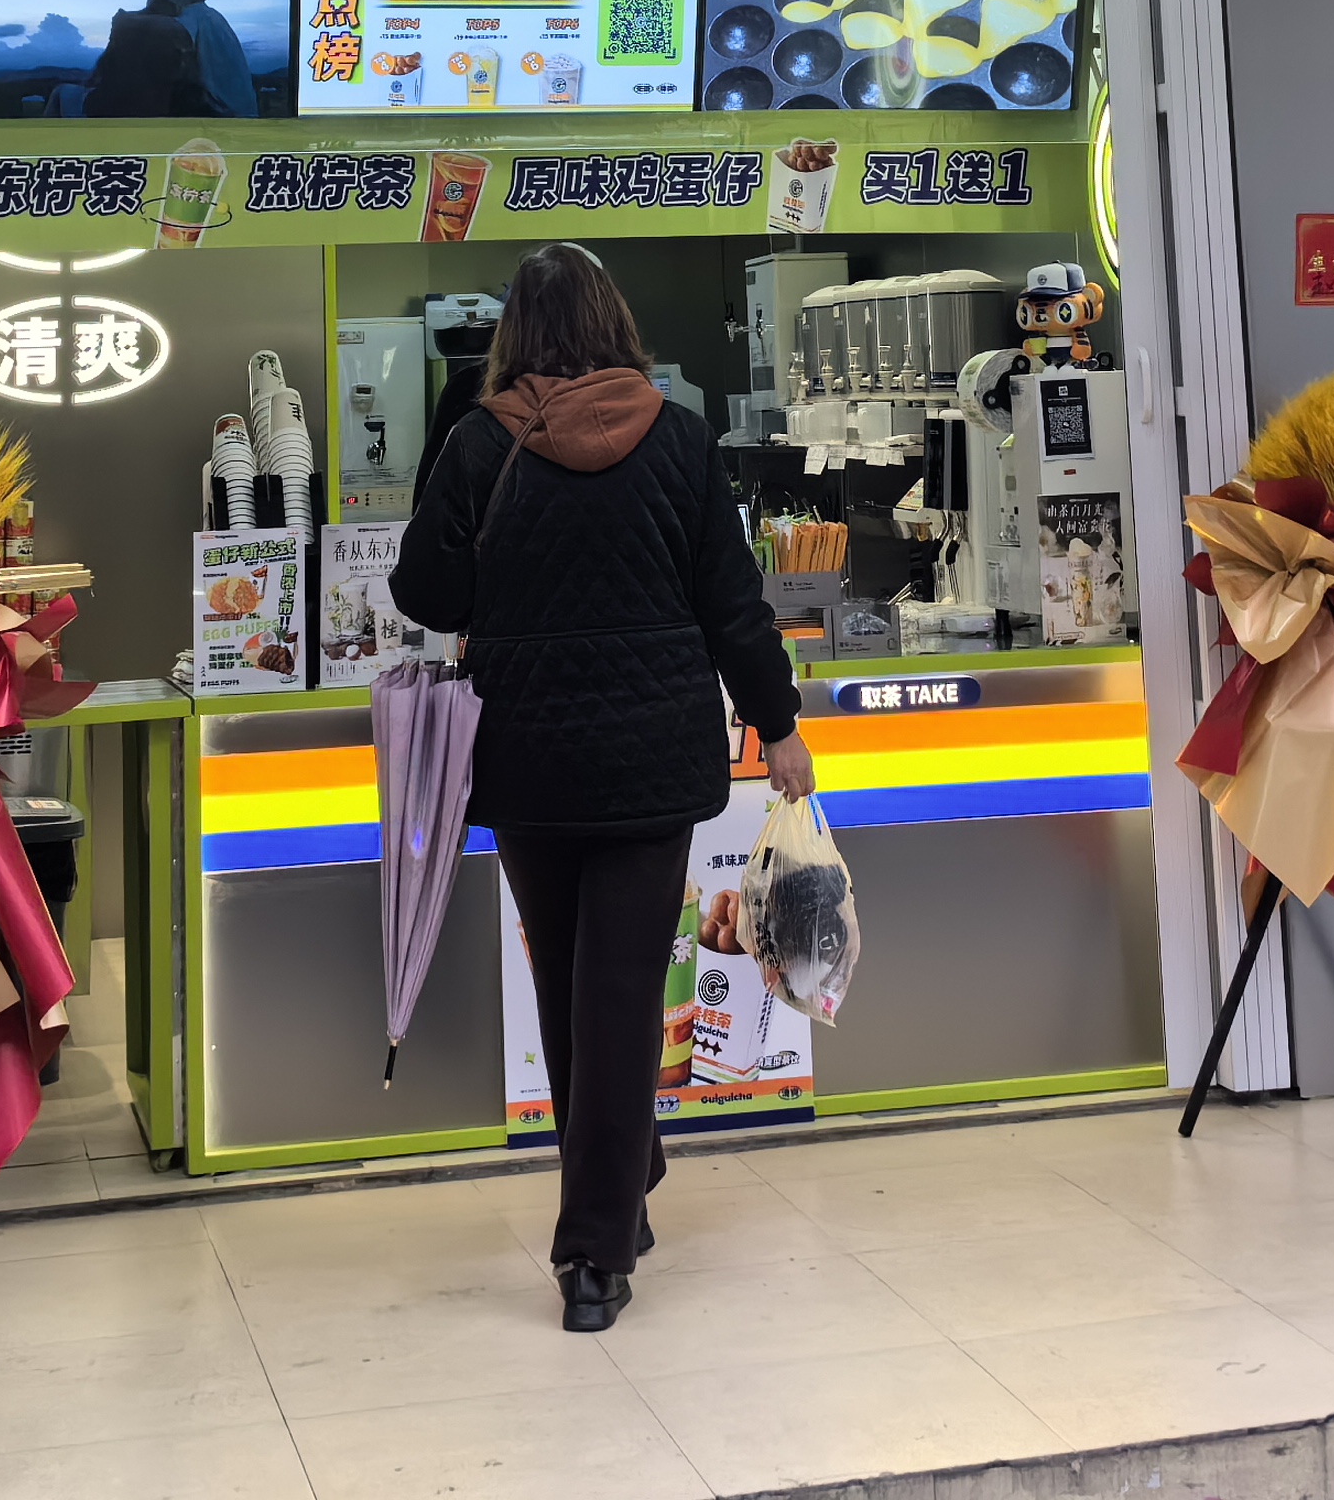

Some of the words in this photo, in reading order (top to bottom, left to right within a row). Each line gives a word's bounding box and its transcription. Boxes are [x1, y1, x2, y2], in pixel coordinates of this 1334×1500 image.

[248, 156, 416, 209] 热柠茶
[506, 154, 763, 210] 原味鸡蛋仔
[862, 150, 1034, 205] 买1送1
[203, 537, 297, 567] 蛋仔新公式
[380, 618, 398, 640] 桂
[860, 683, 902, 709] 取茶
[905, 683, 959, 705] TAKE
[701, 1092, 753, 1105] Guiguicha
